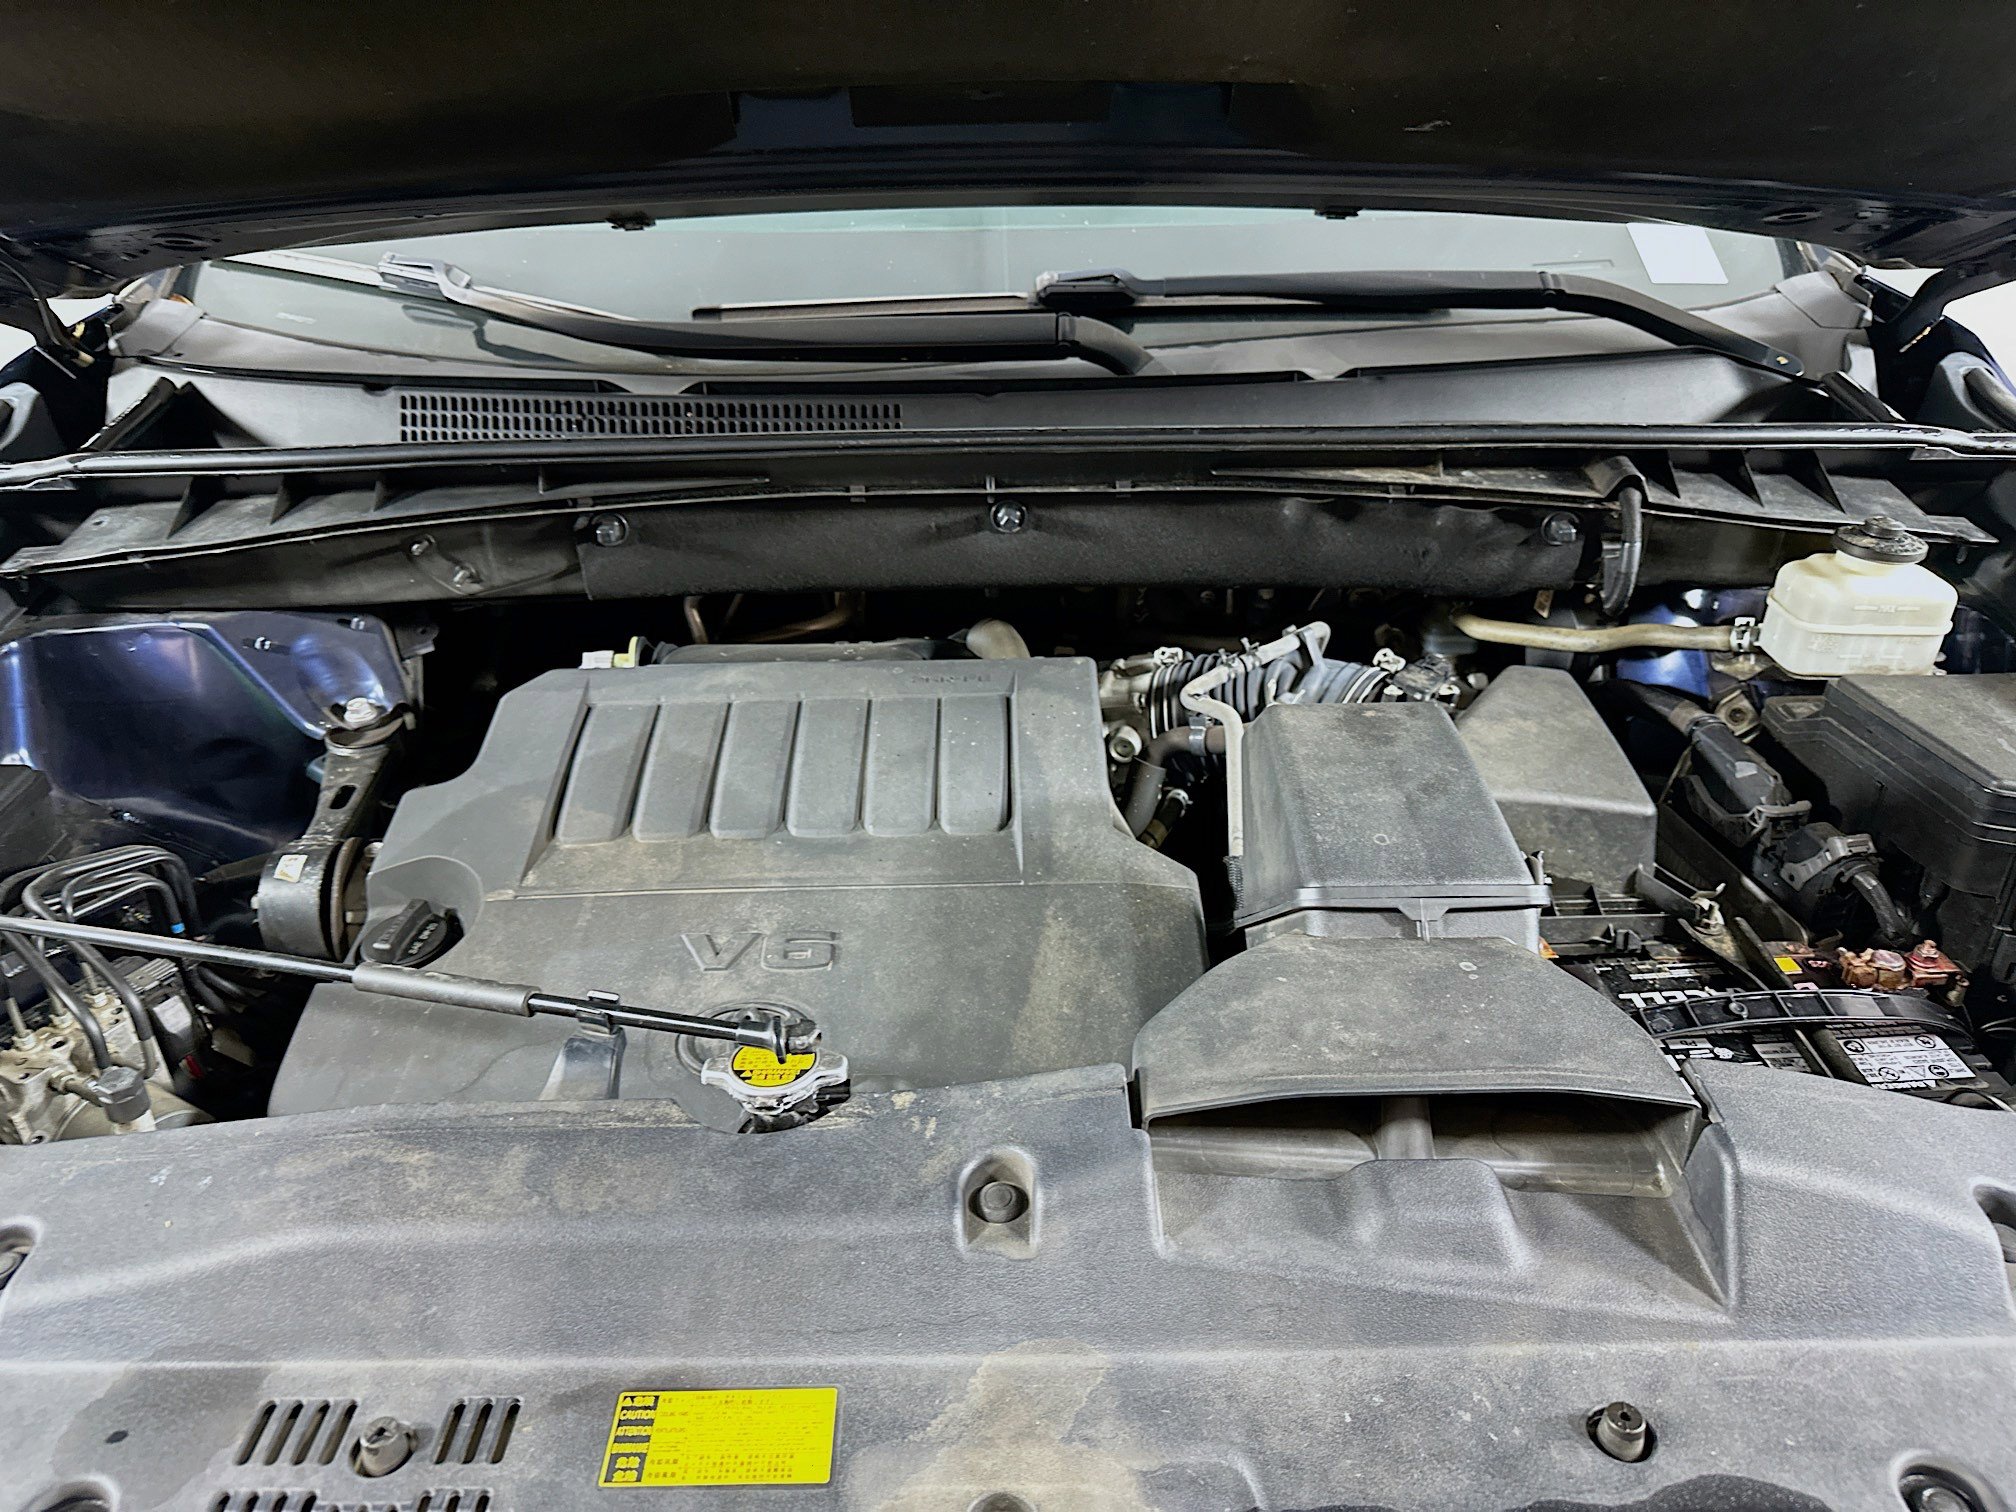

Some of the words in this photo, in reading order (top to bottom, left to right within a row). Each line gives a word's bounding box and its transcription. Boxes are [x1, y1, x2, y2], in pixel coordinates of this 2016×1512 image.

[408, 941, 423, 954] SAE
[680, 931, 838, 971] V6
[620, 1409, 657, 1421] CAUTION
